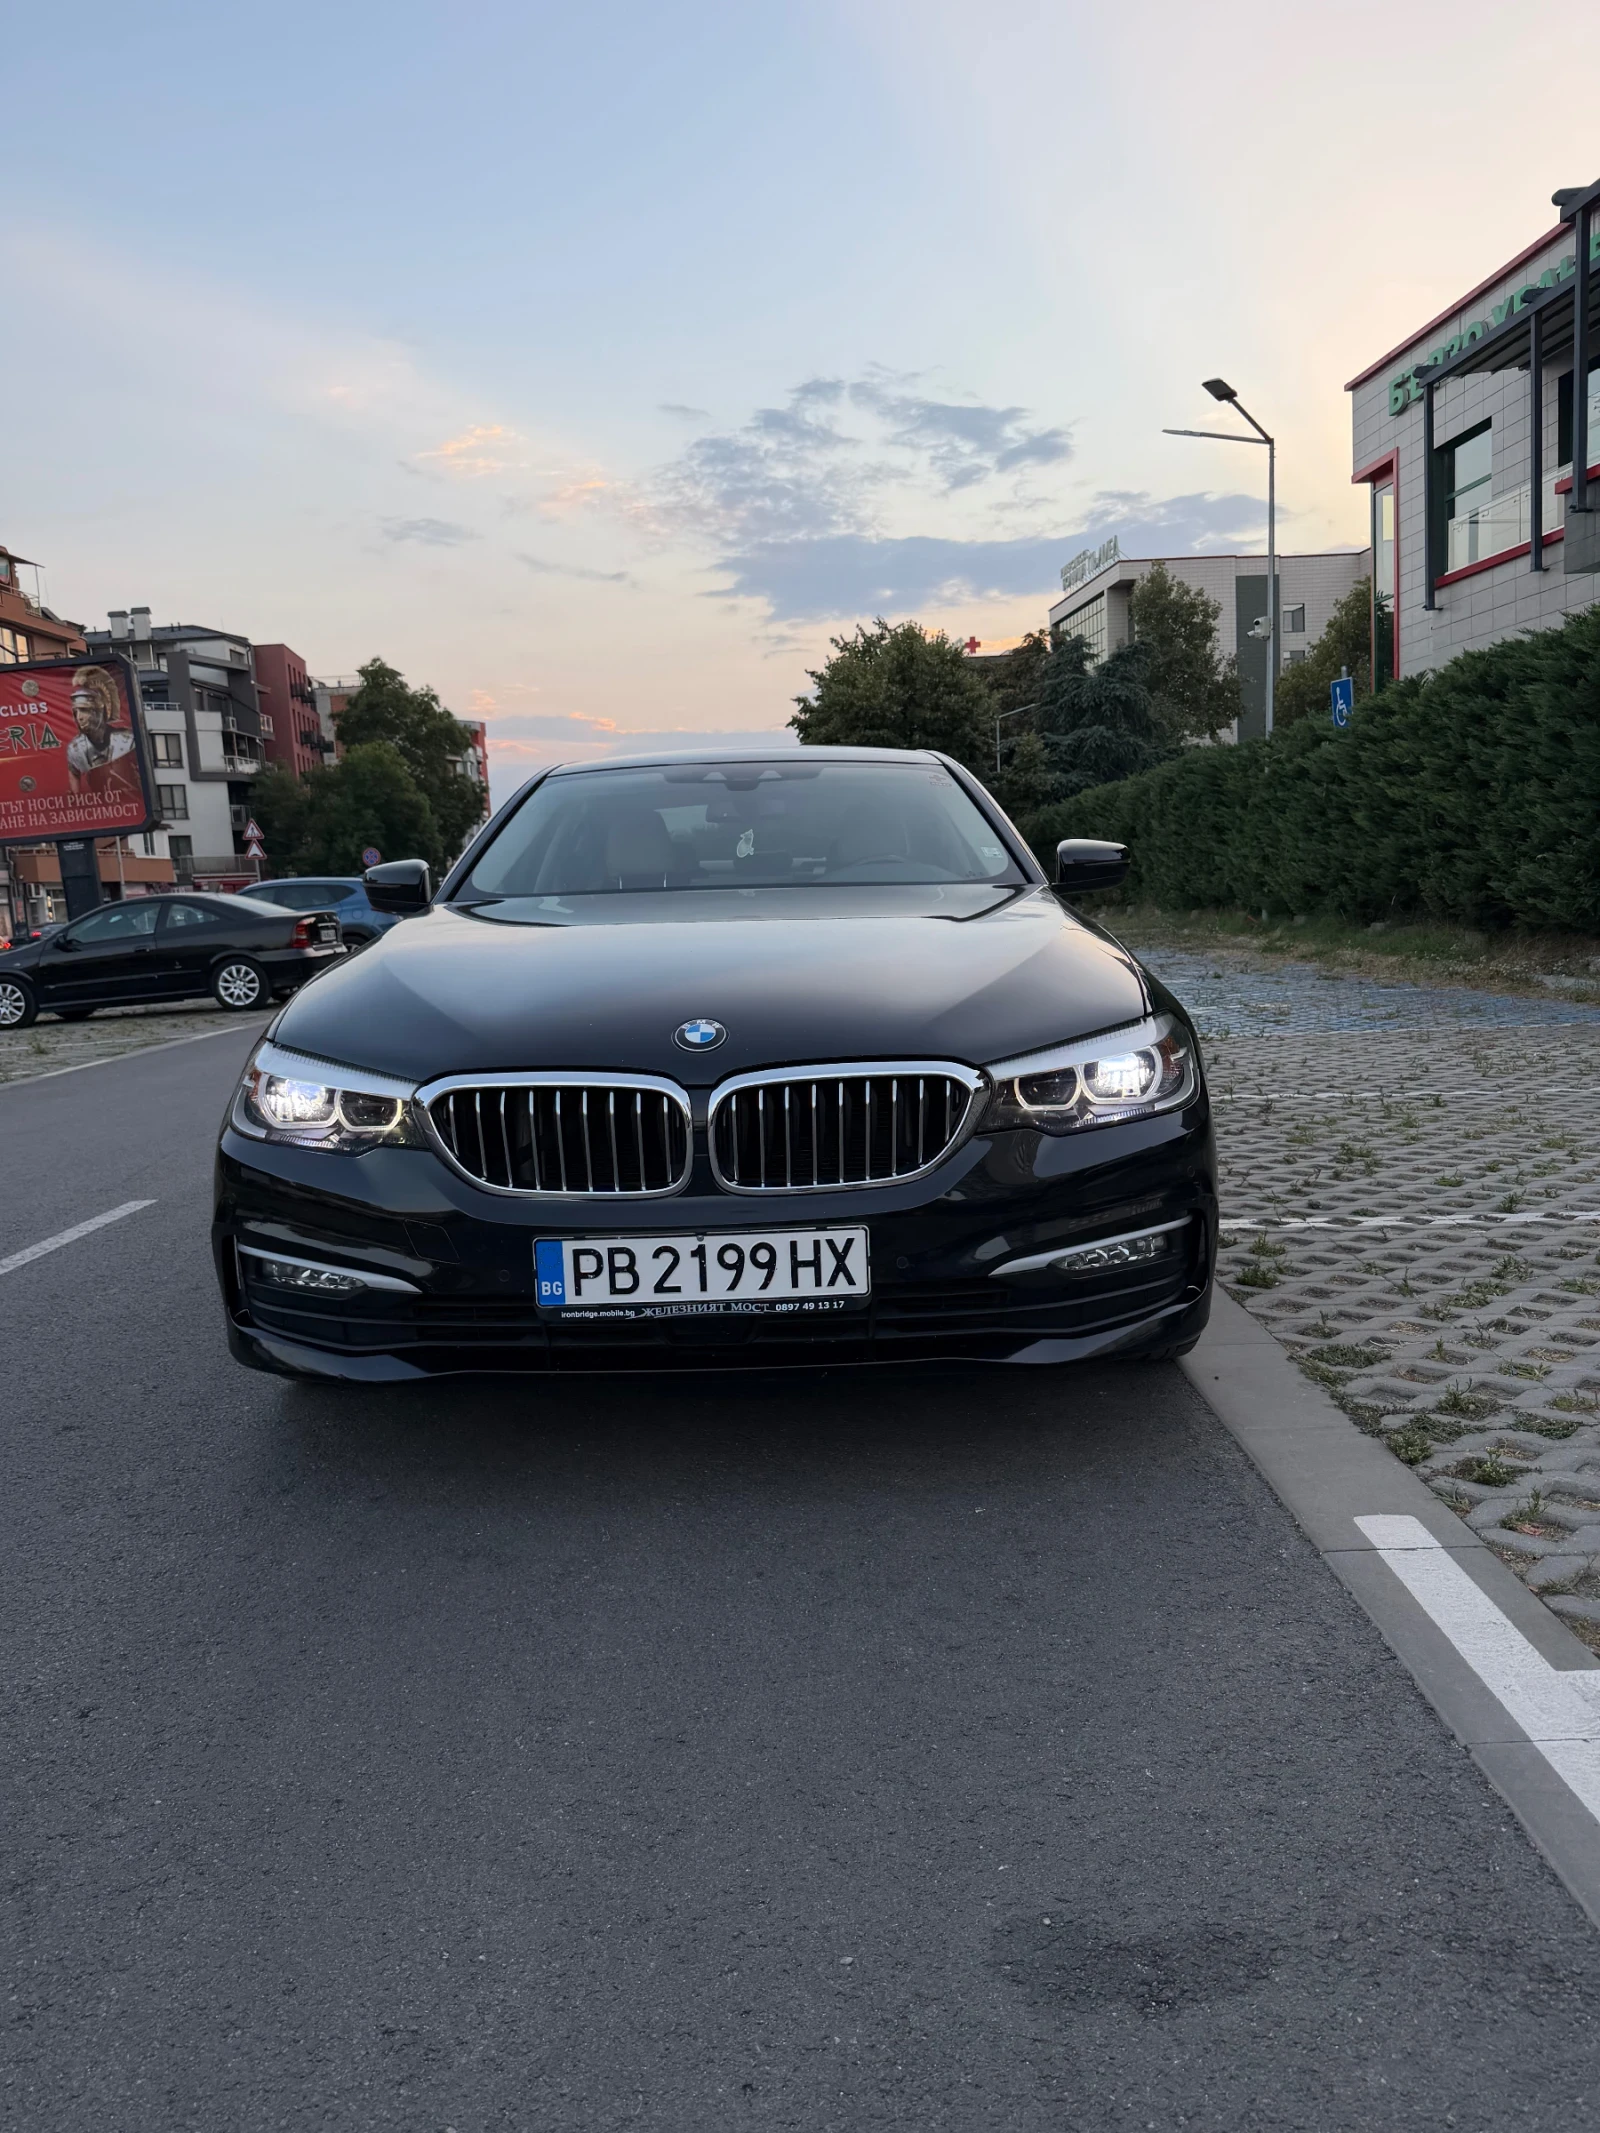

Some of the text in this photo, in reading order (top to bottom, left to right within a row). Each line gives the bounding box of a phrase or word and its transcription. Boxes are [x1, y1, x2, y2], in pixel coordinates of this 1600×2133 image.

[0, 702, 48, 717] CLUBS
[28, 796, 65, 811] НОСИ
[67, 792, 102, 807] РИСК
[104, 790, 122, 804] ОТ
[29, 813, 47, 826] НА
[50, 803, 138, 823] ЗАВИСИМОСТ
[541, 1281, 562, 1296] BG
[640, 1303, 770, 1317] ЖЕЛЕЗНИЯТ МОСТ
[775, 1303, 800, 1311] 0897
[803, 1302, 815, 1310] 49
[833, 1300, 845, 1308] 17
[561, 1309, 635, 1318] ironbridge.mobile.bg
